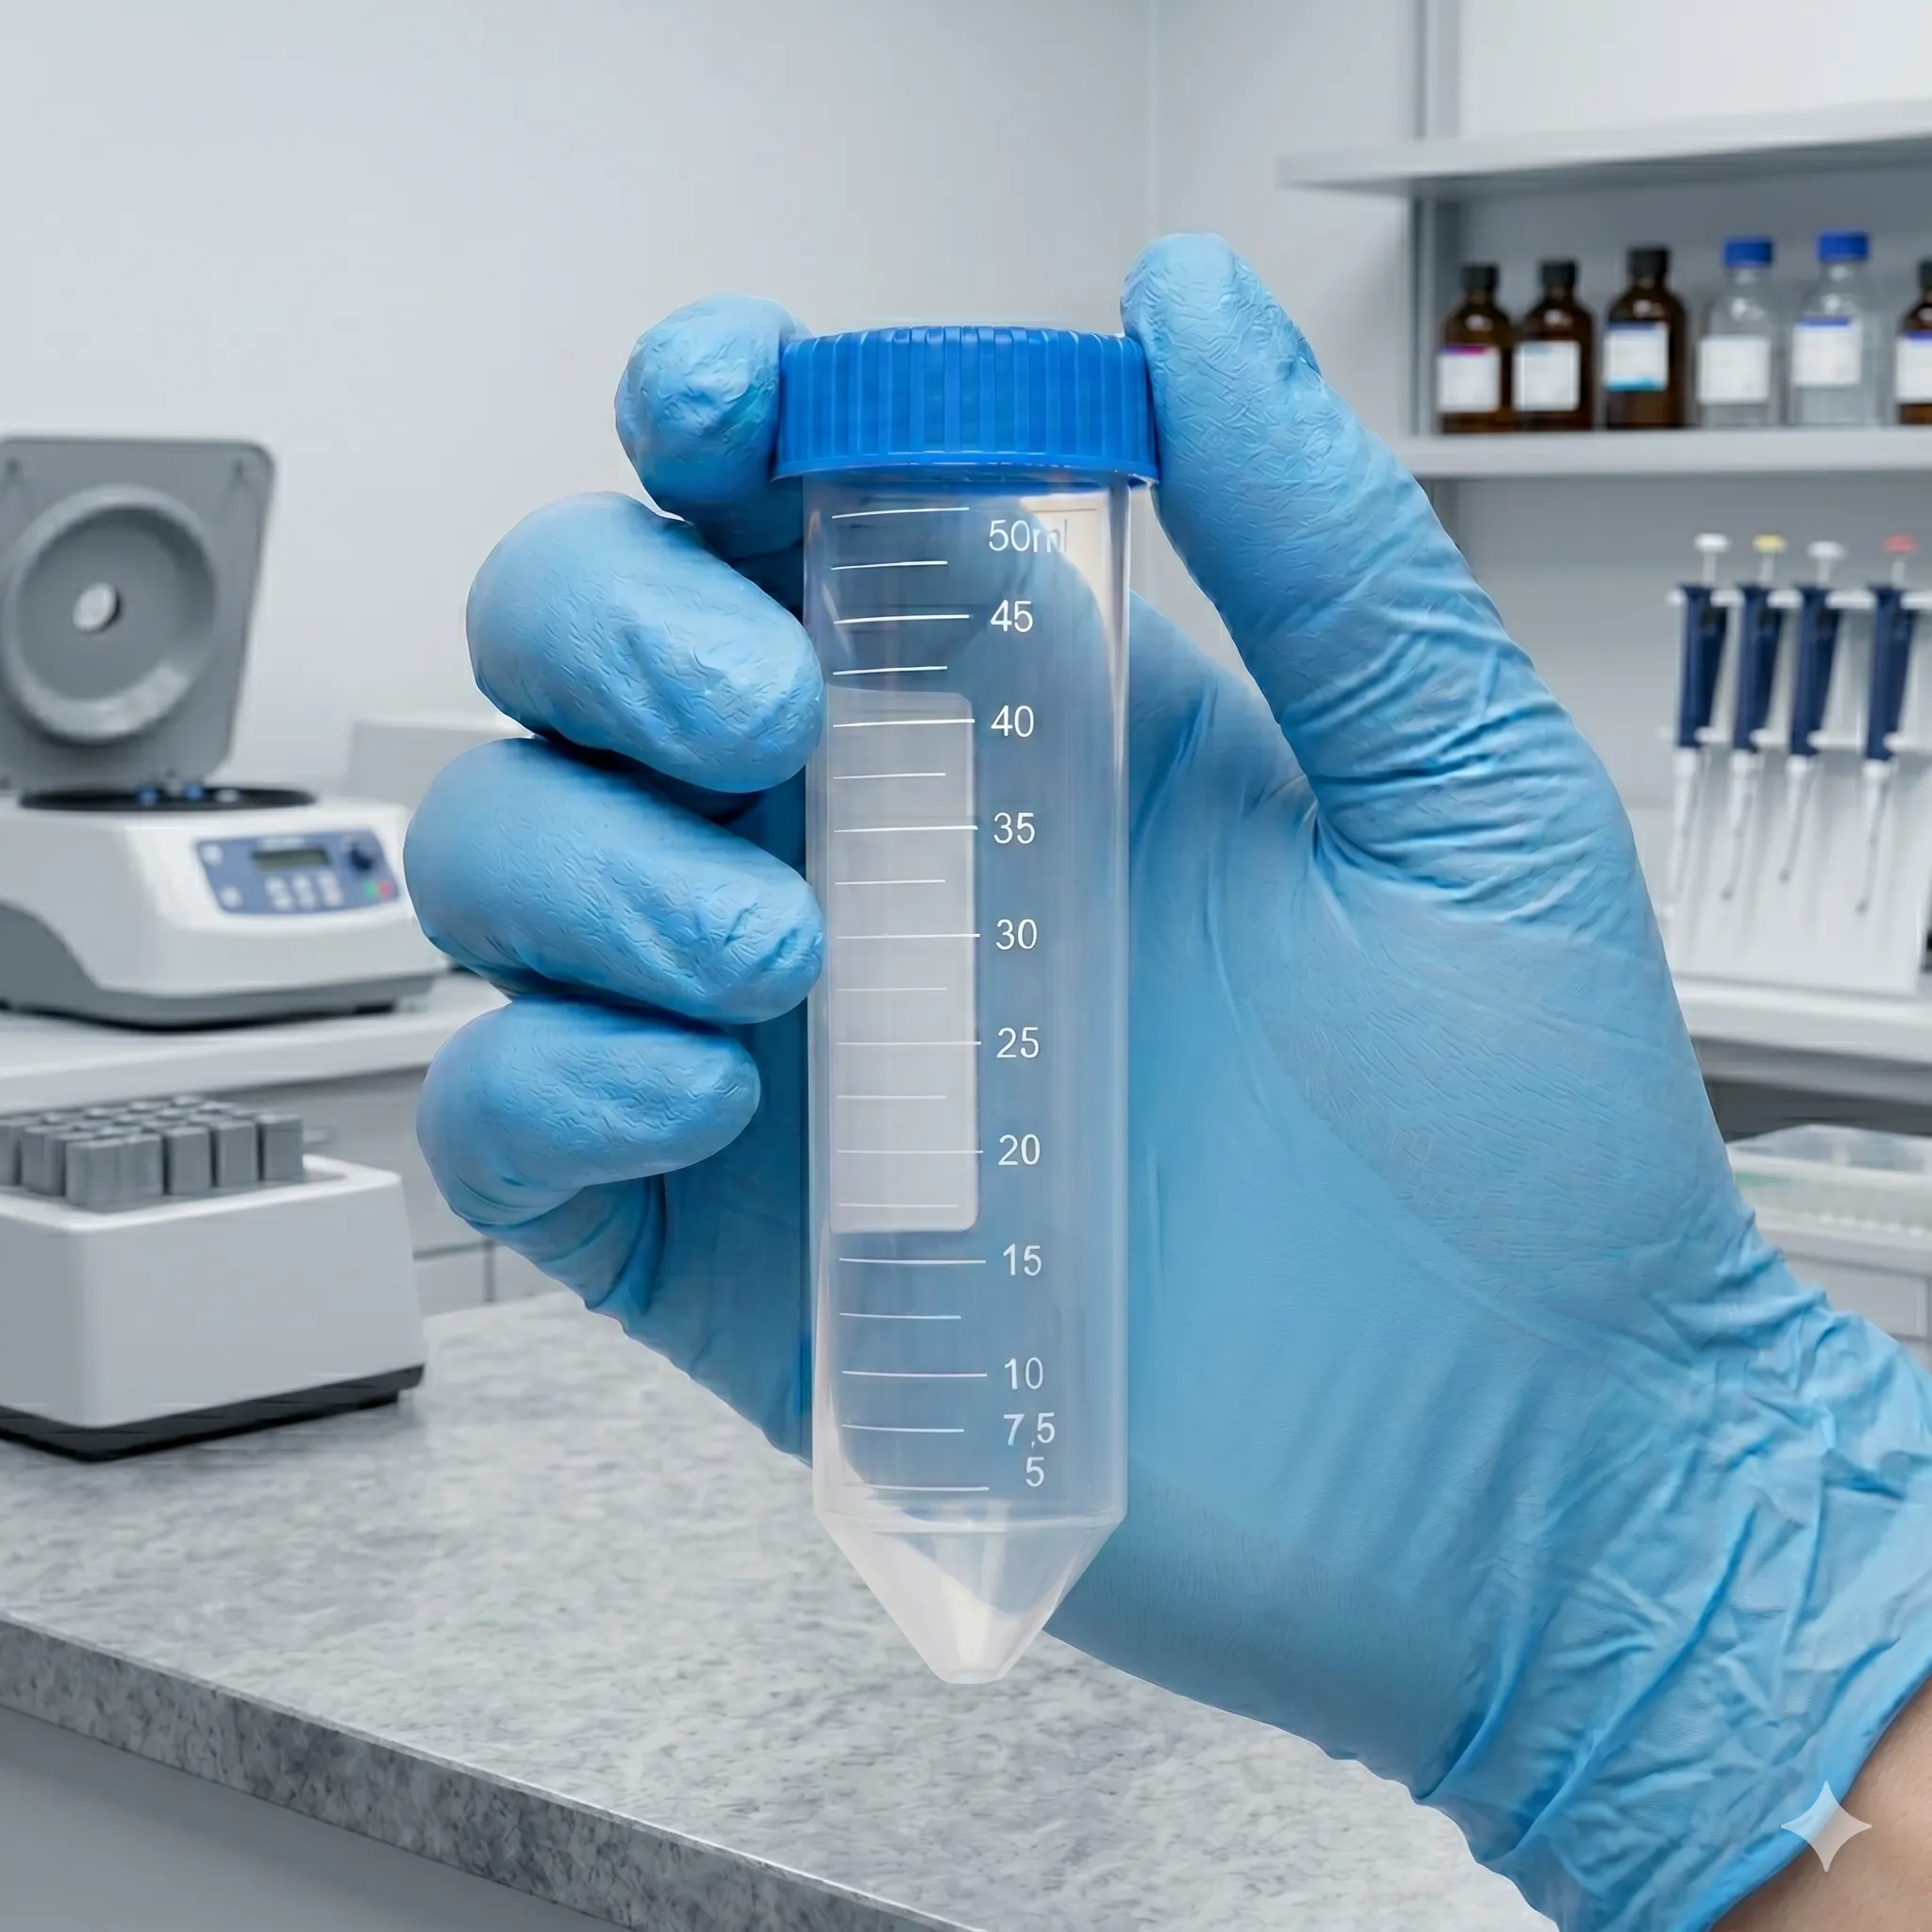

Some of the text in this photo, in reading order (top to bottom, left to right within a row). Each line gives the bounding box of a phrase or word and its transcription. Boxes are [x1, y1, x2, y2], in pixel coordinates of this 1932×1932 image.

[989, 519, 1068, 553] 50ml
[990, 599, 1034, 633] 45
[990, 705, 1035, 738] 40
[992, 811, 1036, 844] 35
[994, 918, 1038, 951] 30
[996, 1026, 1040, 1058] 25
[998, 1133, 1041, 1166] 20
[1003, 1243, 1042, 1276] 15
[1004, 1357, 1044, 1390] 10
[1025, 1457, 1045, 1488] 5
